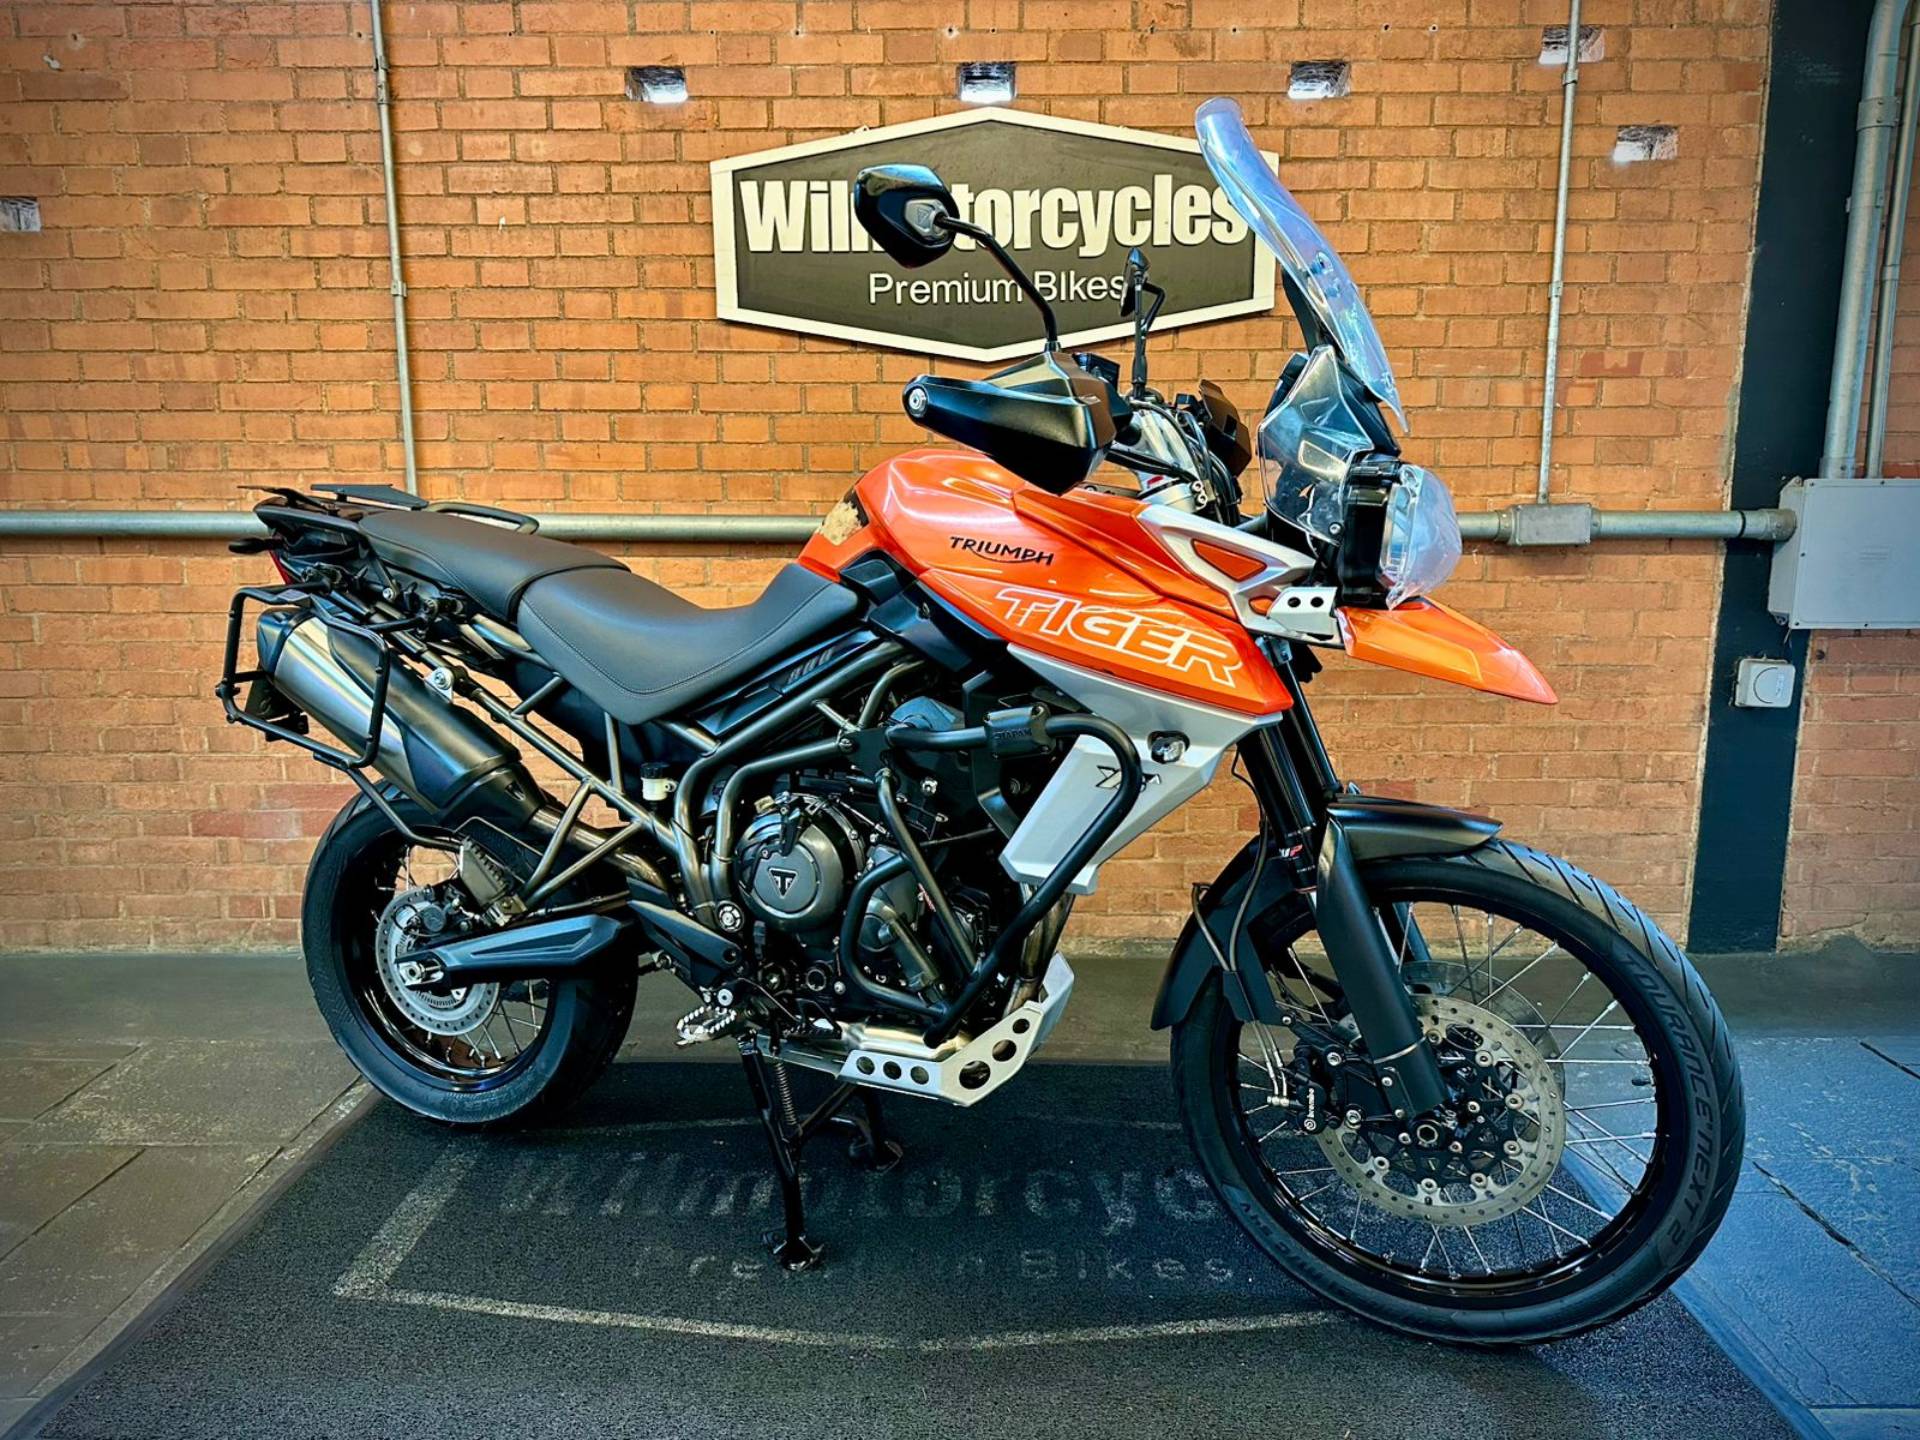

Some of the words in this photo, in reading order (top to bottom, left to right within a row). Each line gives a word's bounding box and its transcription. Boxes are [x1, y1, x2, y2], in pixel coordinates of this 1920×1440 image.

[869, 272, 1023, 304] Premium
[950, 536, 1054, 566] TRIUMPH
[996, 588, 1243, 688] TIGER
[1617, 952, 1714, 1124] TOURANCE
[1684, 1128, 1713, 1221] NEXT
[1667, 1217, 1687, 1247] 2
